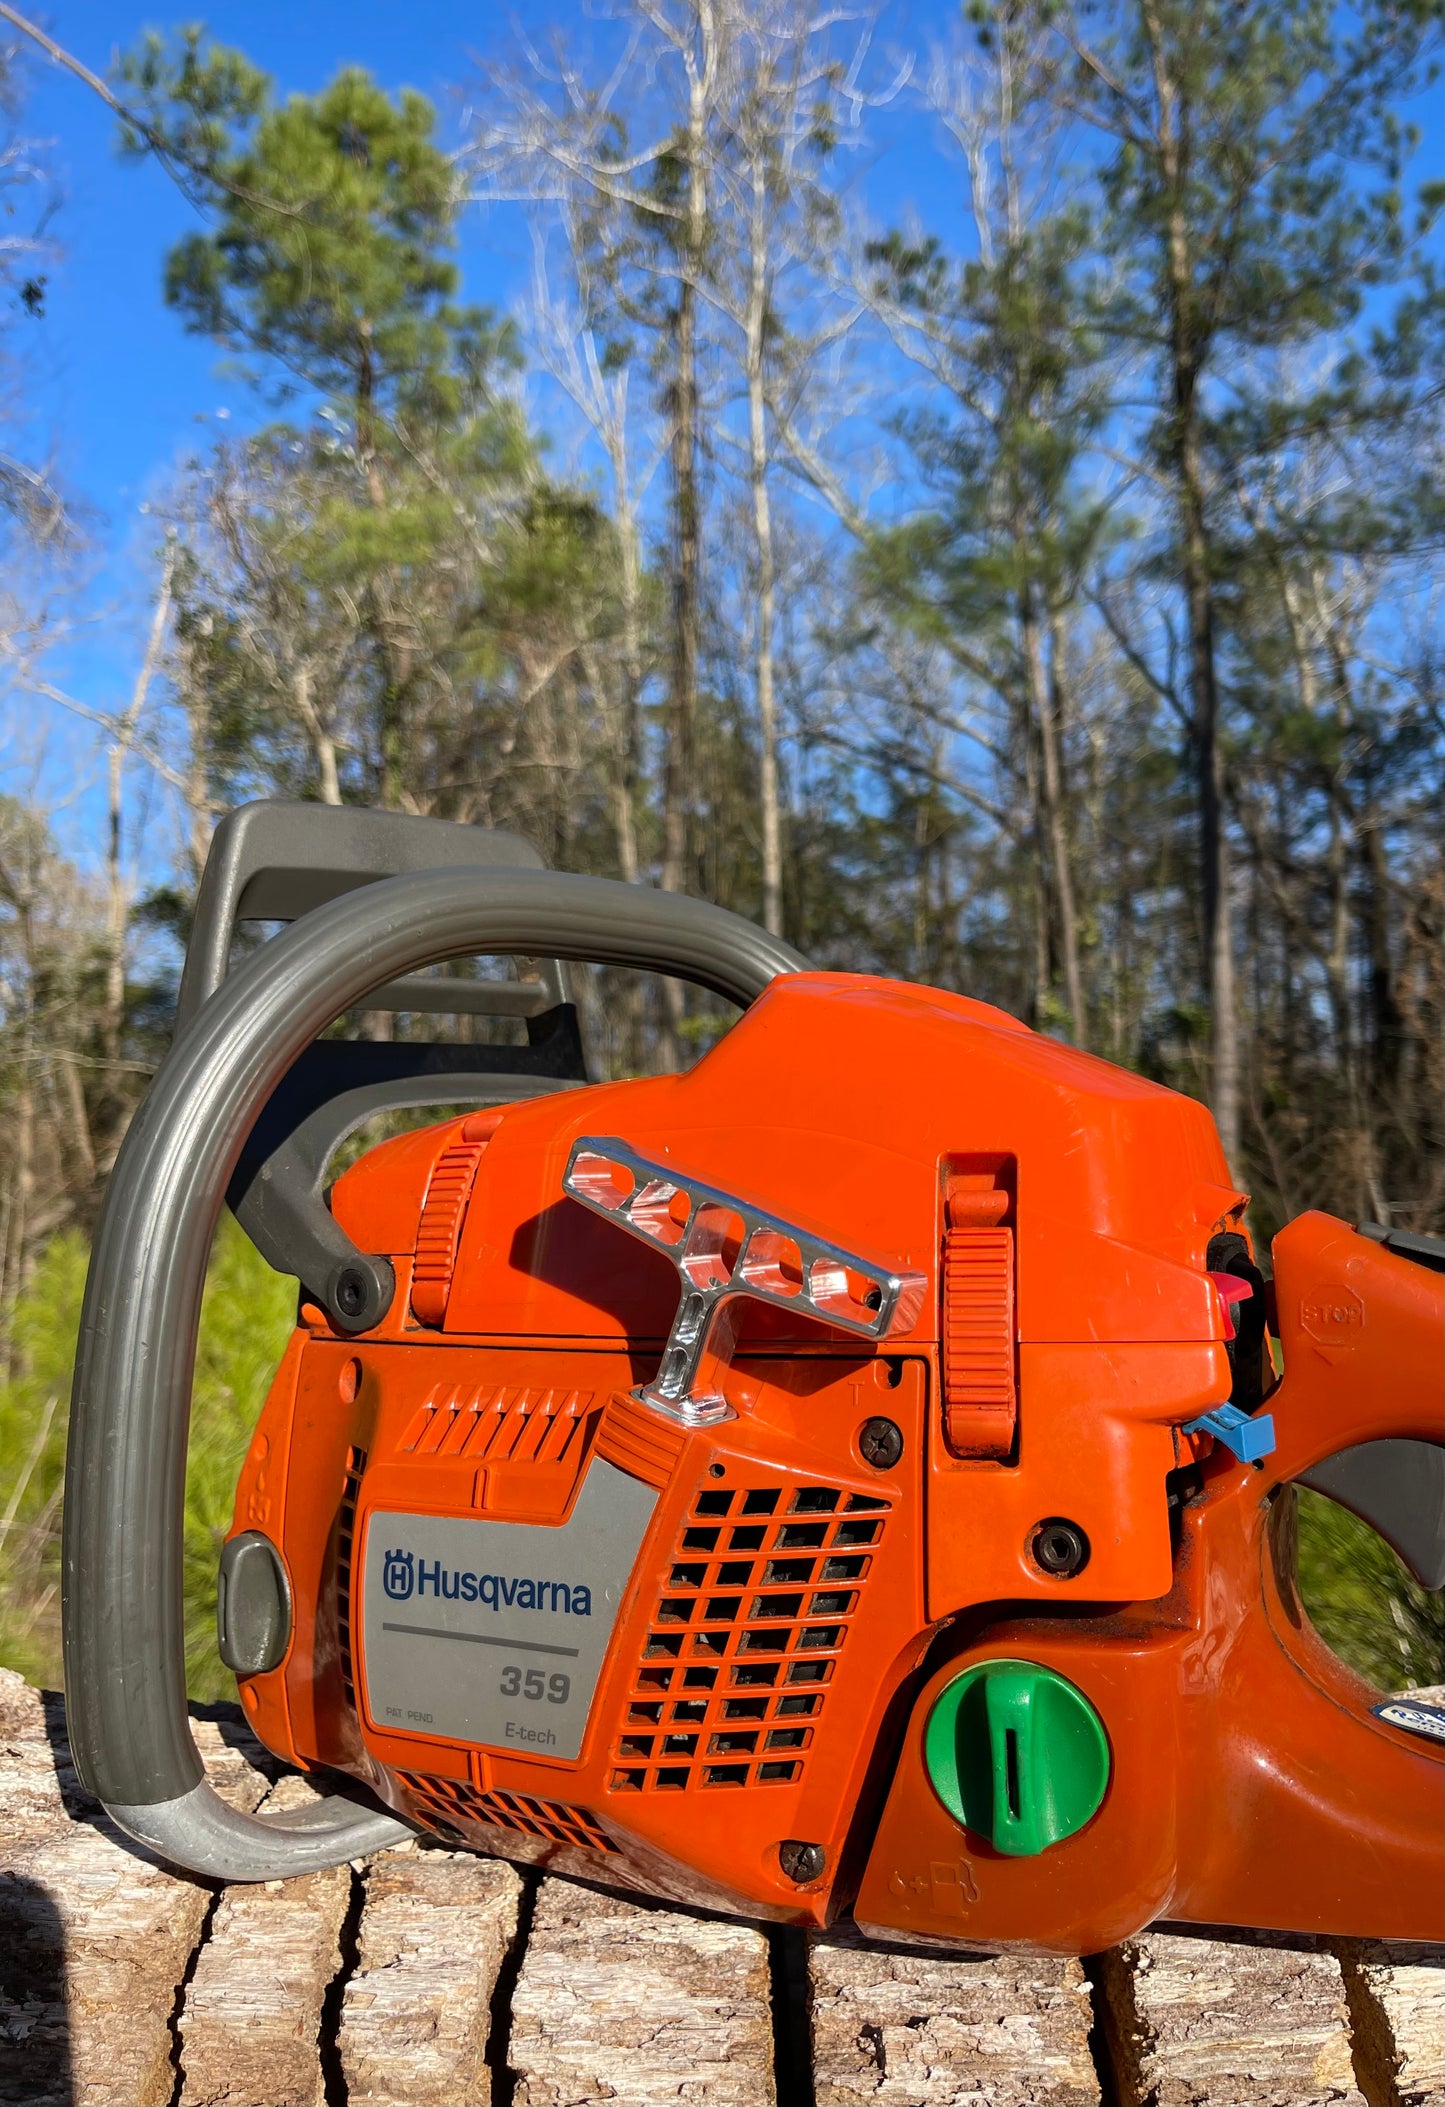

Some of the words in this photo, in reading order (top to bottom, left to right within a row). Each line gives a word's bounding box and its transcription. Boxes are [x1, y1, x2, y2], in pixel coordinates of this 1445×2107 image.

[1305, 1304, 1361, 1324] STOP
[418, 1559, 591, 1616] Husqvarna
[500, 1665, 571, 1704] 359
[505, 1721, 556, 1745] E-tech
